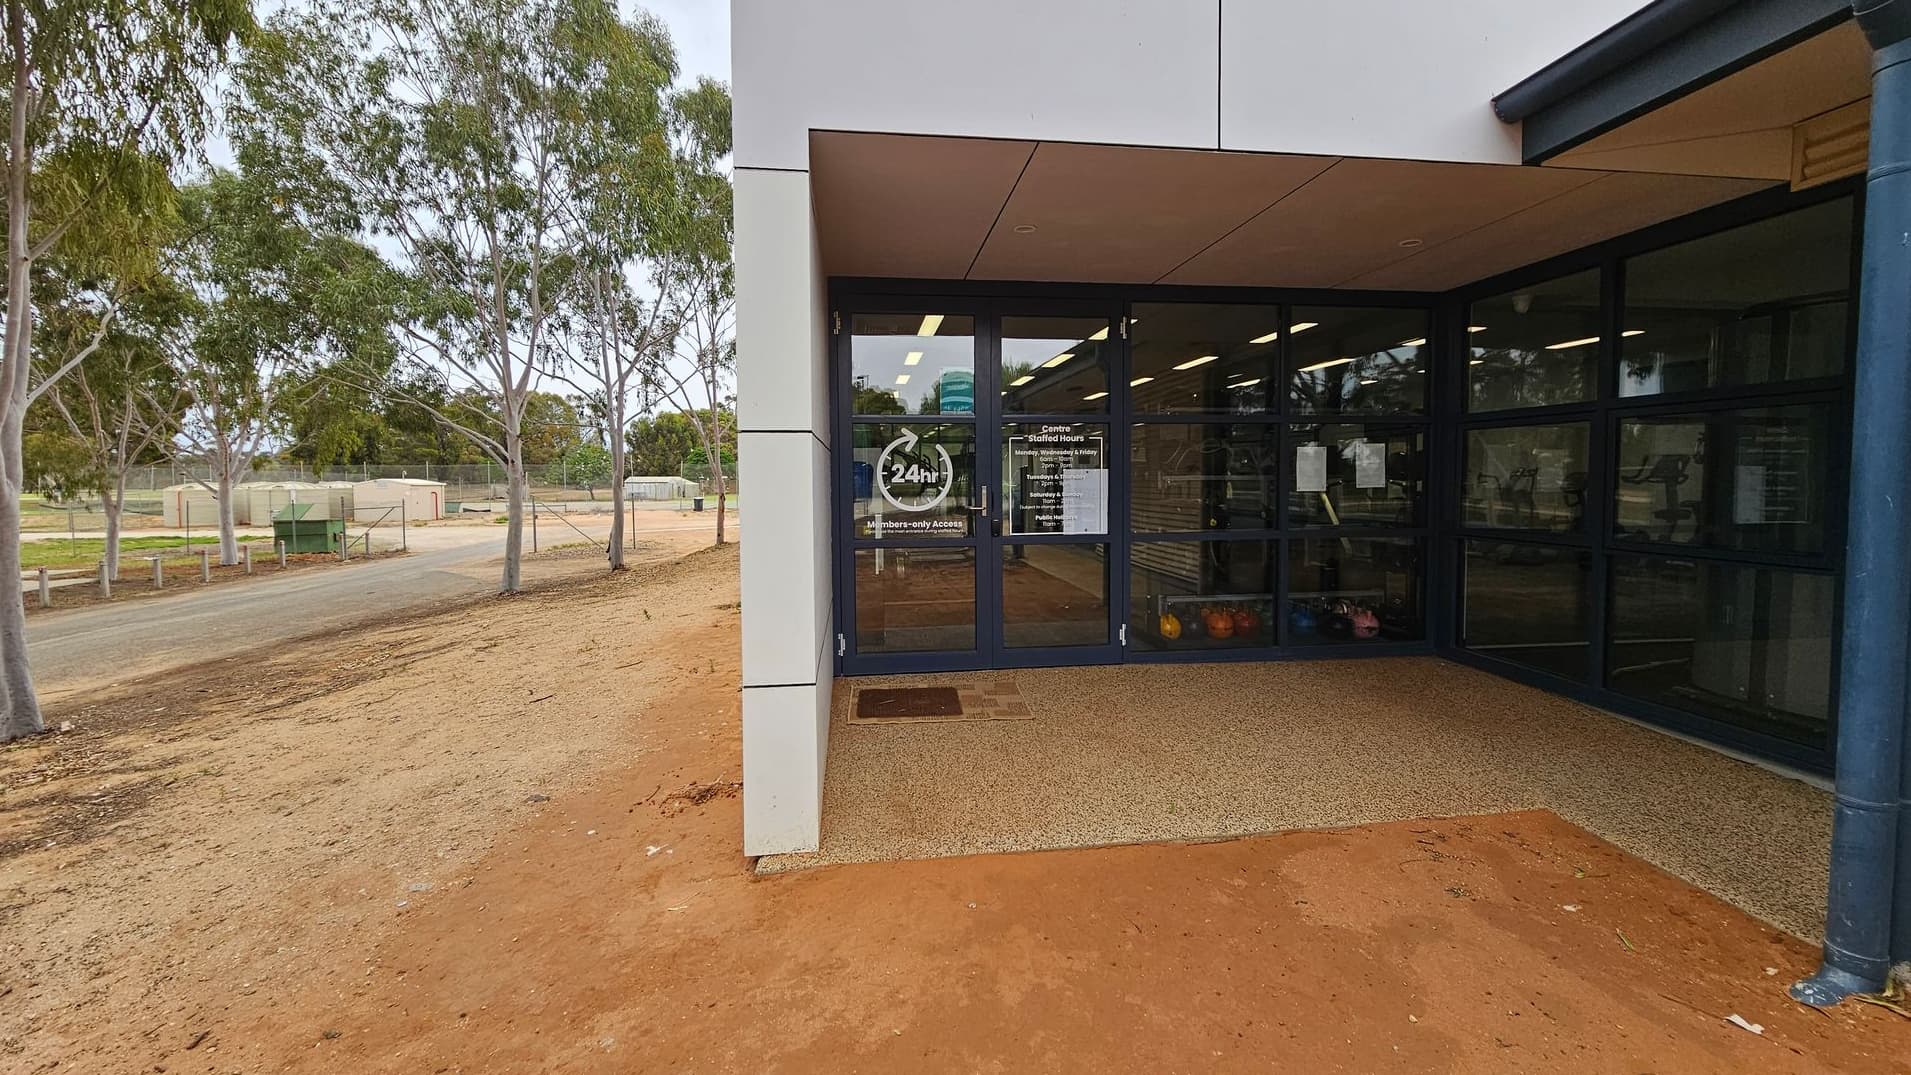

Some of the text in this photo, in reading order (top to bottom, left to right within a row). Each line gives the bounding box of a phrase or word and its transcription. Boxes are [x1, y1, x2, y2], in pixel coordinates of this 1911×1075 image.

[1028, 434, 1084, 442] Staffed Hours
[891, 464, 938, 483] 24hr
[867, 520, 963, 529] Members-only Access
